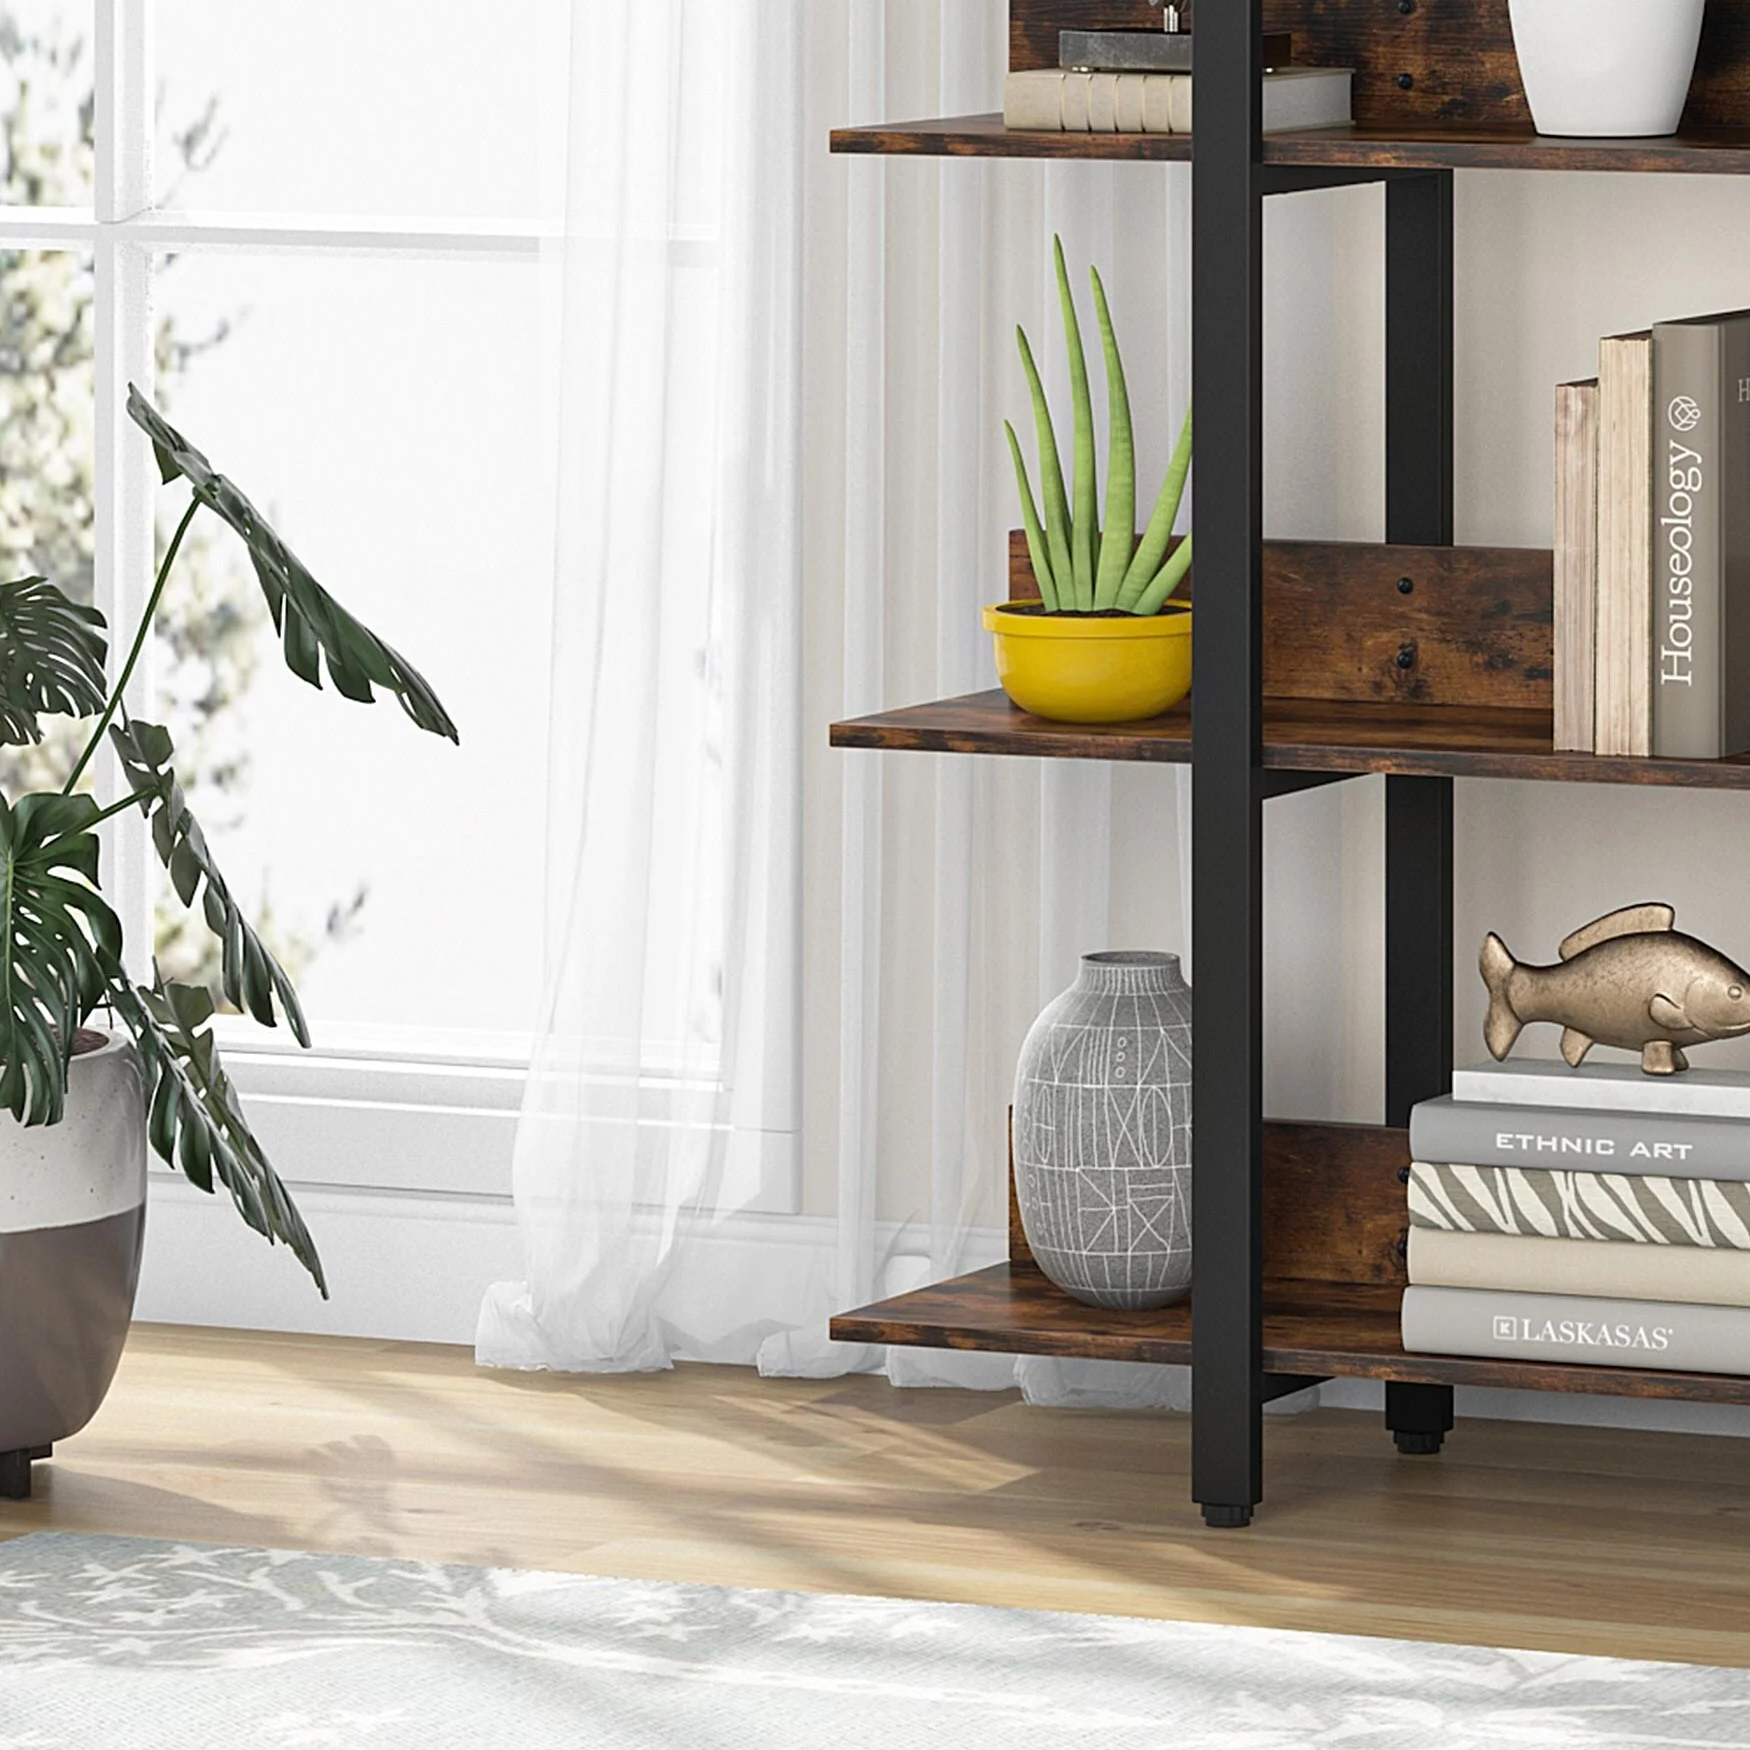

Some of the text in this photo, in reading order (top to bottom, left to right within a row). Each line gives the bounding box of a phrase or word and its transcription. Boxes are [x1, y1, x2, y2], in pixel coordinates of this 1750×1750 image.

[1660, 439, 1702, 687] Houseology
[1496, 1132, 1694, 1160] ETHNIC ART
[1521, 1318, 1669, 1350] LASKASAS
